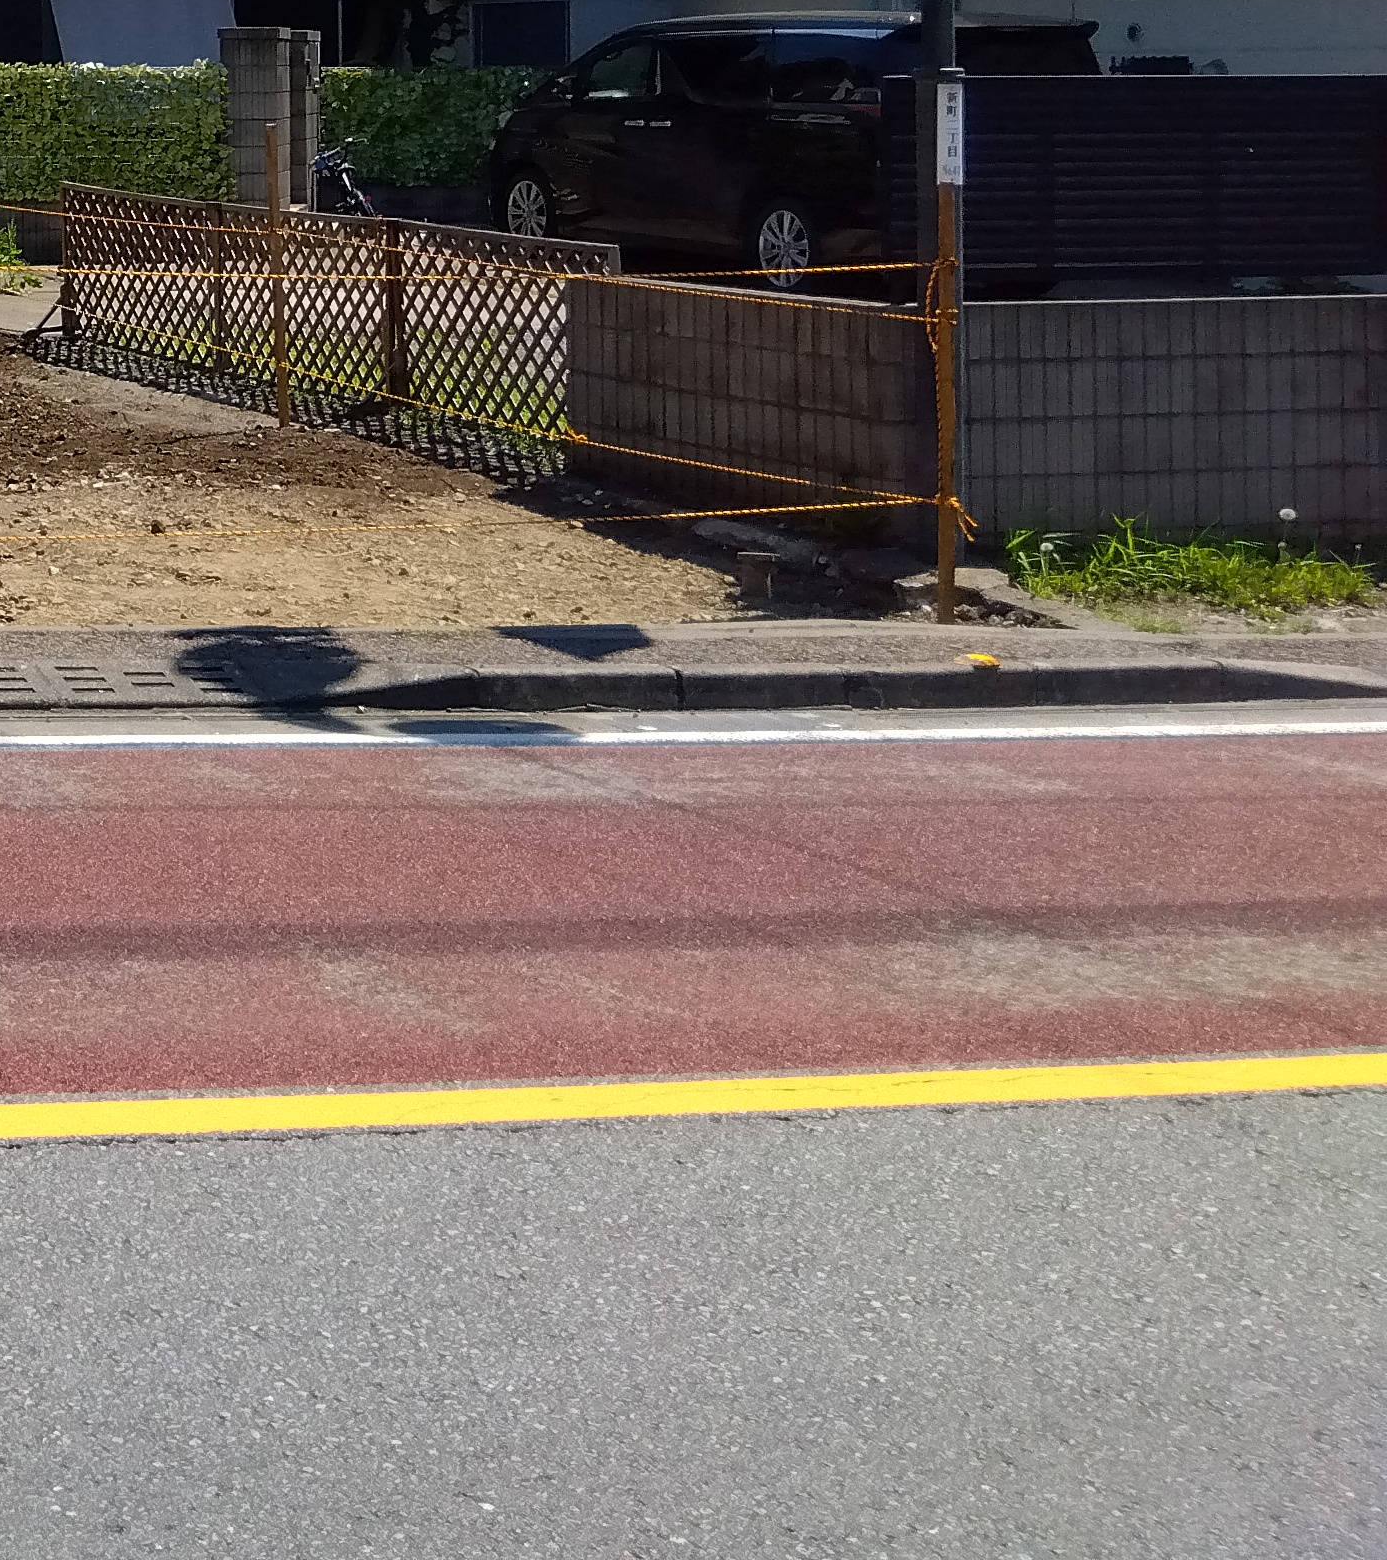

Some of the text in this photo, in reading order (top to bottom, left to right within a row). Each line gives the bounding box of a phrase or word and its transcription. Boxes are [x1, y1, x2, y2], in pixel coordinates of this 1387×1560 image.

[946, 92, 960, 157] 新町二丁目
